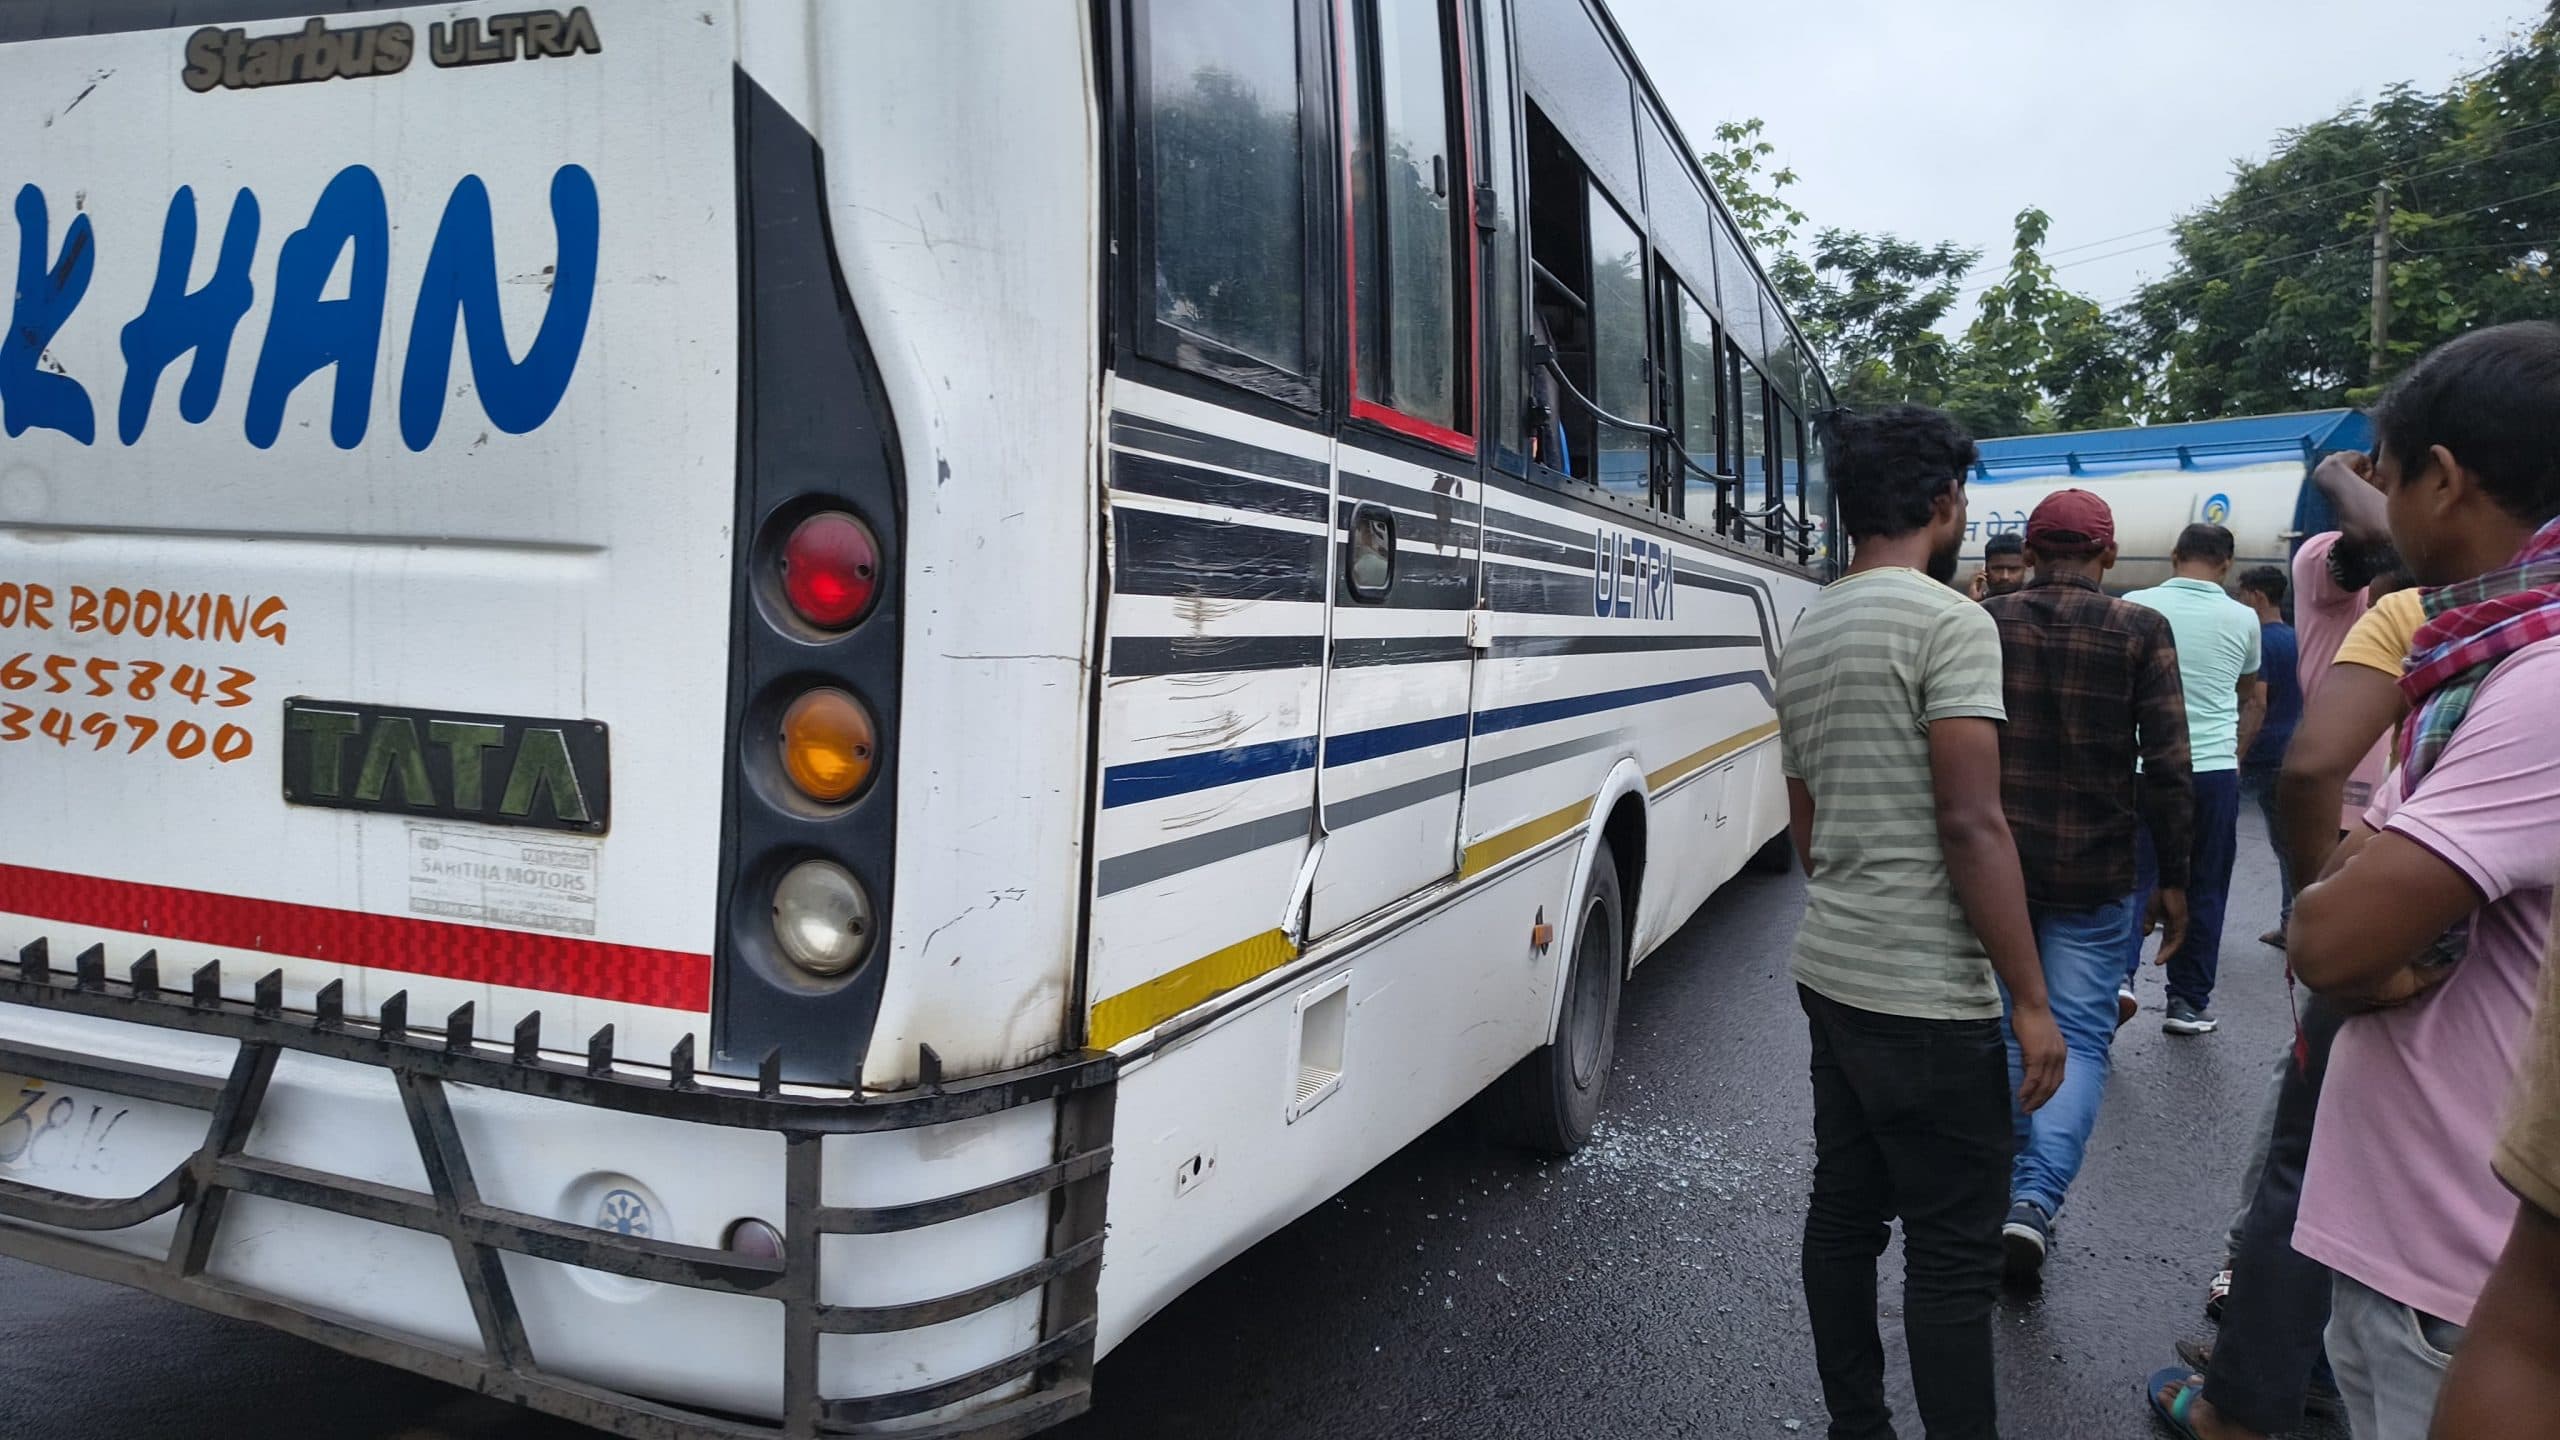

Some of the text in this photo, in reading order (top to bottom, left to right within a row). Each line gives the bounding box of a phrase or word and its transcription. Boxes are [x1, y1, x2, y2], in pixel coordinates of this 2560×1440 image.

[182, 6, 602, 93] Starbus ULTRA
[0, 163, 600, 452] KHAN
[1595, 528, 1673, 620] ULTRA
[70, 586, 288, 646] BOOKING
[0, 652, 256, 707] 655843
[0, 703, 254, 762] 349700
[292, 708, 592, 822] TATA
[421, 857, 500, 881] SARITHA
[506, 866, 587, 891] MOTORS
